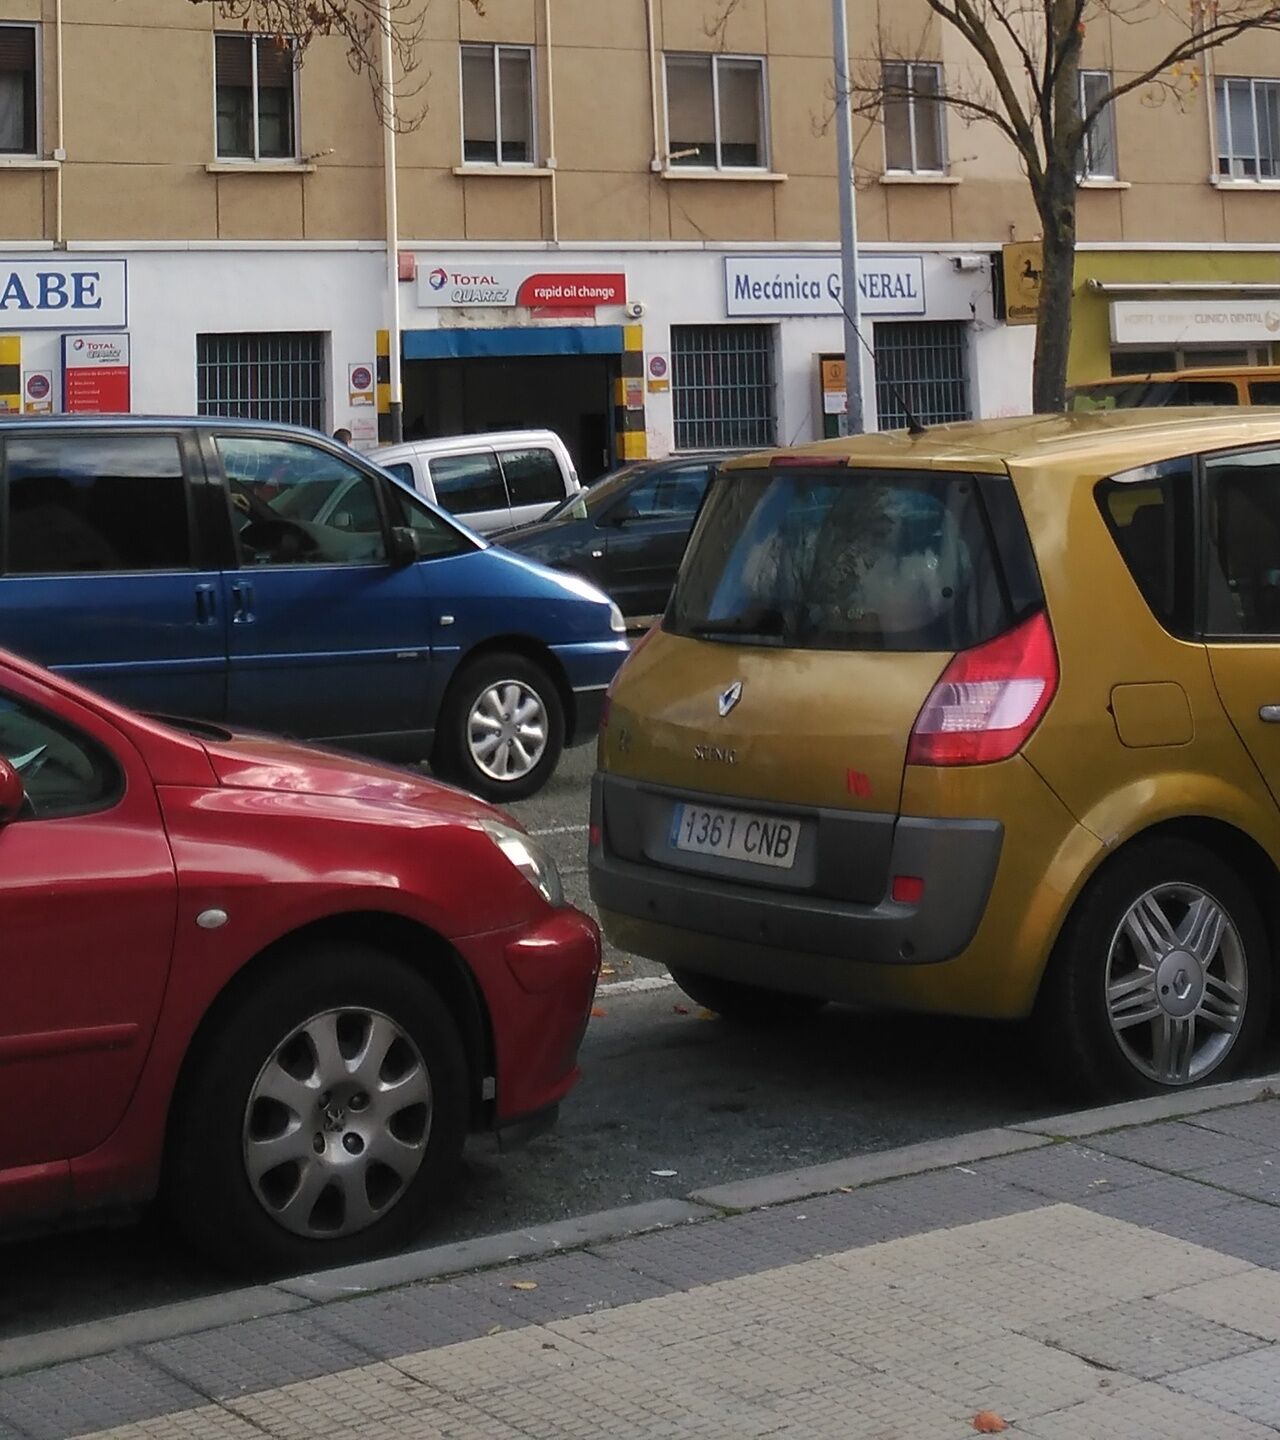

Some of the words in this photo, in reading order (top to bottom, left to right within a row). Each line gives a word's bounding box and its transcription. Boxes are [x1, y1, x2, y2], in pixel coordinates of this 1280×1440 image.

[451, 288, 510, 303] QUARTZ
[534, 285, 562, 301] rapid
[564, 285, 577, 297] oil
[578, 285, 615, 301] change
[734, 273, 821, 300] Mecánica
[827, 273, 917, 300] GNERAL
[686, 811, 737, 849] 1361
[744, 820, 792, 858] CNB
